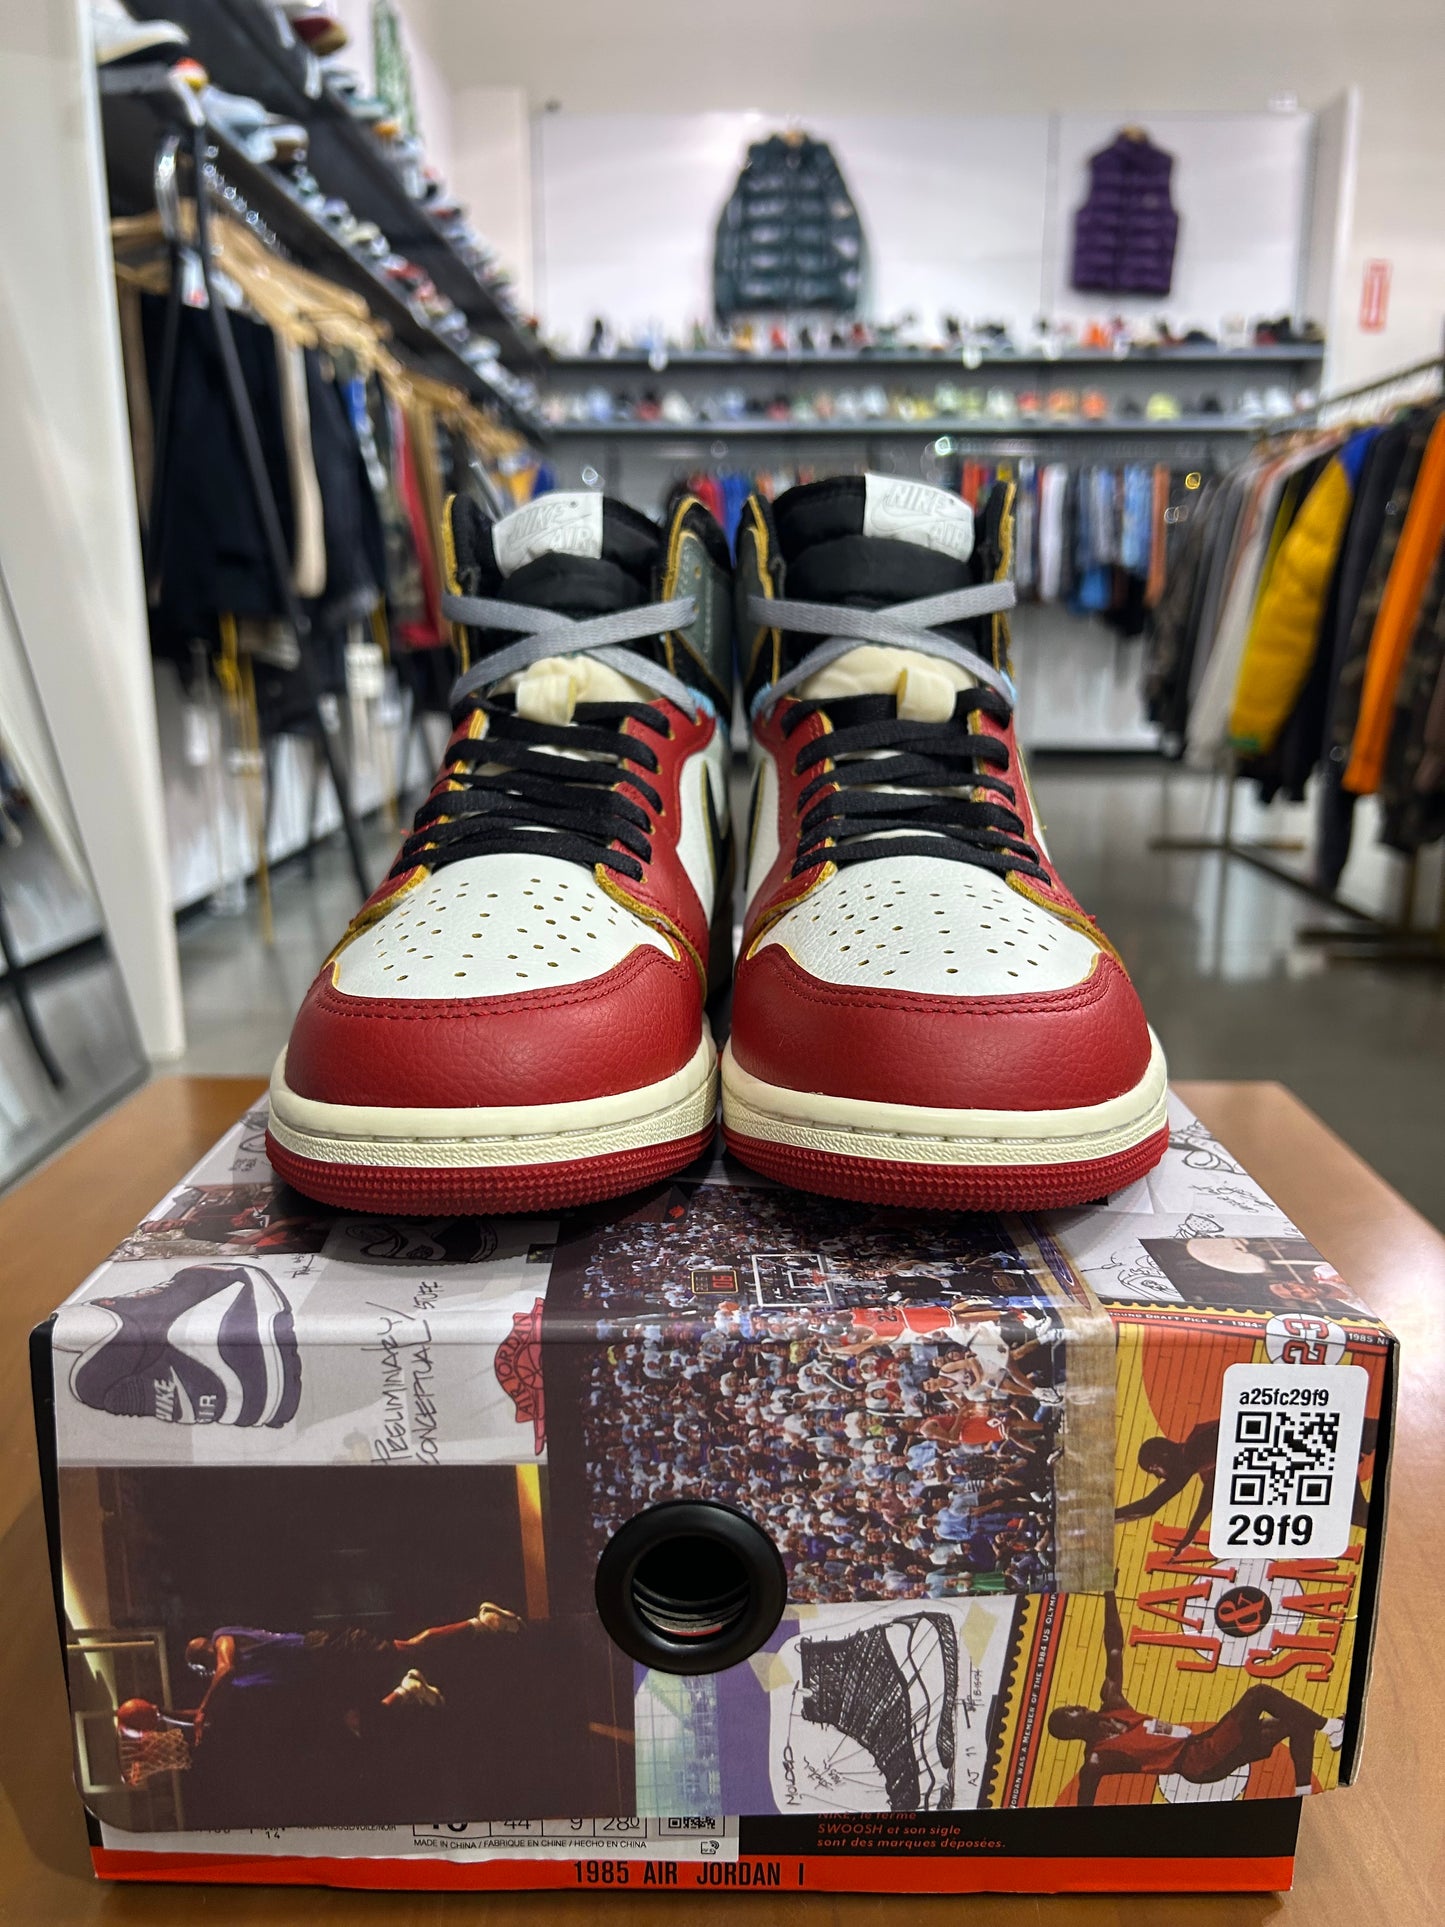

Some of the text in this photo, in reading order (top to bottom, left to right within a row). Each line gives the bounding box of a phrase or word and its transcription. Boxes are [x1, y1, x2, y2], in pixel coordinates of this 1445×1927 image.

[883, 483, 943, 516] NIKE
[506, 502, 566, 546] NIKE
[928, 519, 970, 552] AIR
[549, 525, 598, 556] AIR
[1281, 1317, 1329, 1365] 23
[1348, 1333, 1374, 1343] 1985
[500, 1316, 535, 1417] AIR JORDAN
[154, 1379, 176, 1421] NIKE
[412, 1319, 440, 1465] CONCEPTUAL
[1239, 1387, 1329, 1406] a25fc29f9
[1227, 1514, 1314, 1546] 29f9
[1129, 1520, 1237, 1673] JAM
[1217, 1593, 1266, 1634] &
[1042, 1629, 1050, 1641] US
[1038, 1646, 1047, 1667] 1984
[1034, 1672, 1042, 1688] THE
[1023, 1707, 1036, 1743] MEMBER
[1018, 1756, 1026, 1774] WAS
[413, 1839, 438, 1847] MADE
[450, 1841, 475, 1849] CHINA
[484, 1840, 525, 1848] FABRIQUE
[574, 1840, 604, 1848] HECHO
[606, 1840, 618, 1848] EN
[620, 1840, 647, 1848] CHINA
[817, 1836, 1006, 1850] sont des marques déposées.
[818, 1823, 961, 1837] SWOOSH et son sigle
[574, 1860, 804, 1886] 1985 AIR JORDAN I
